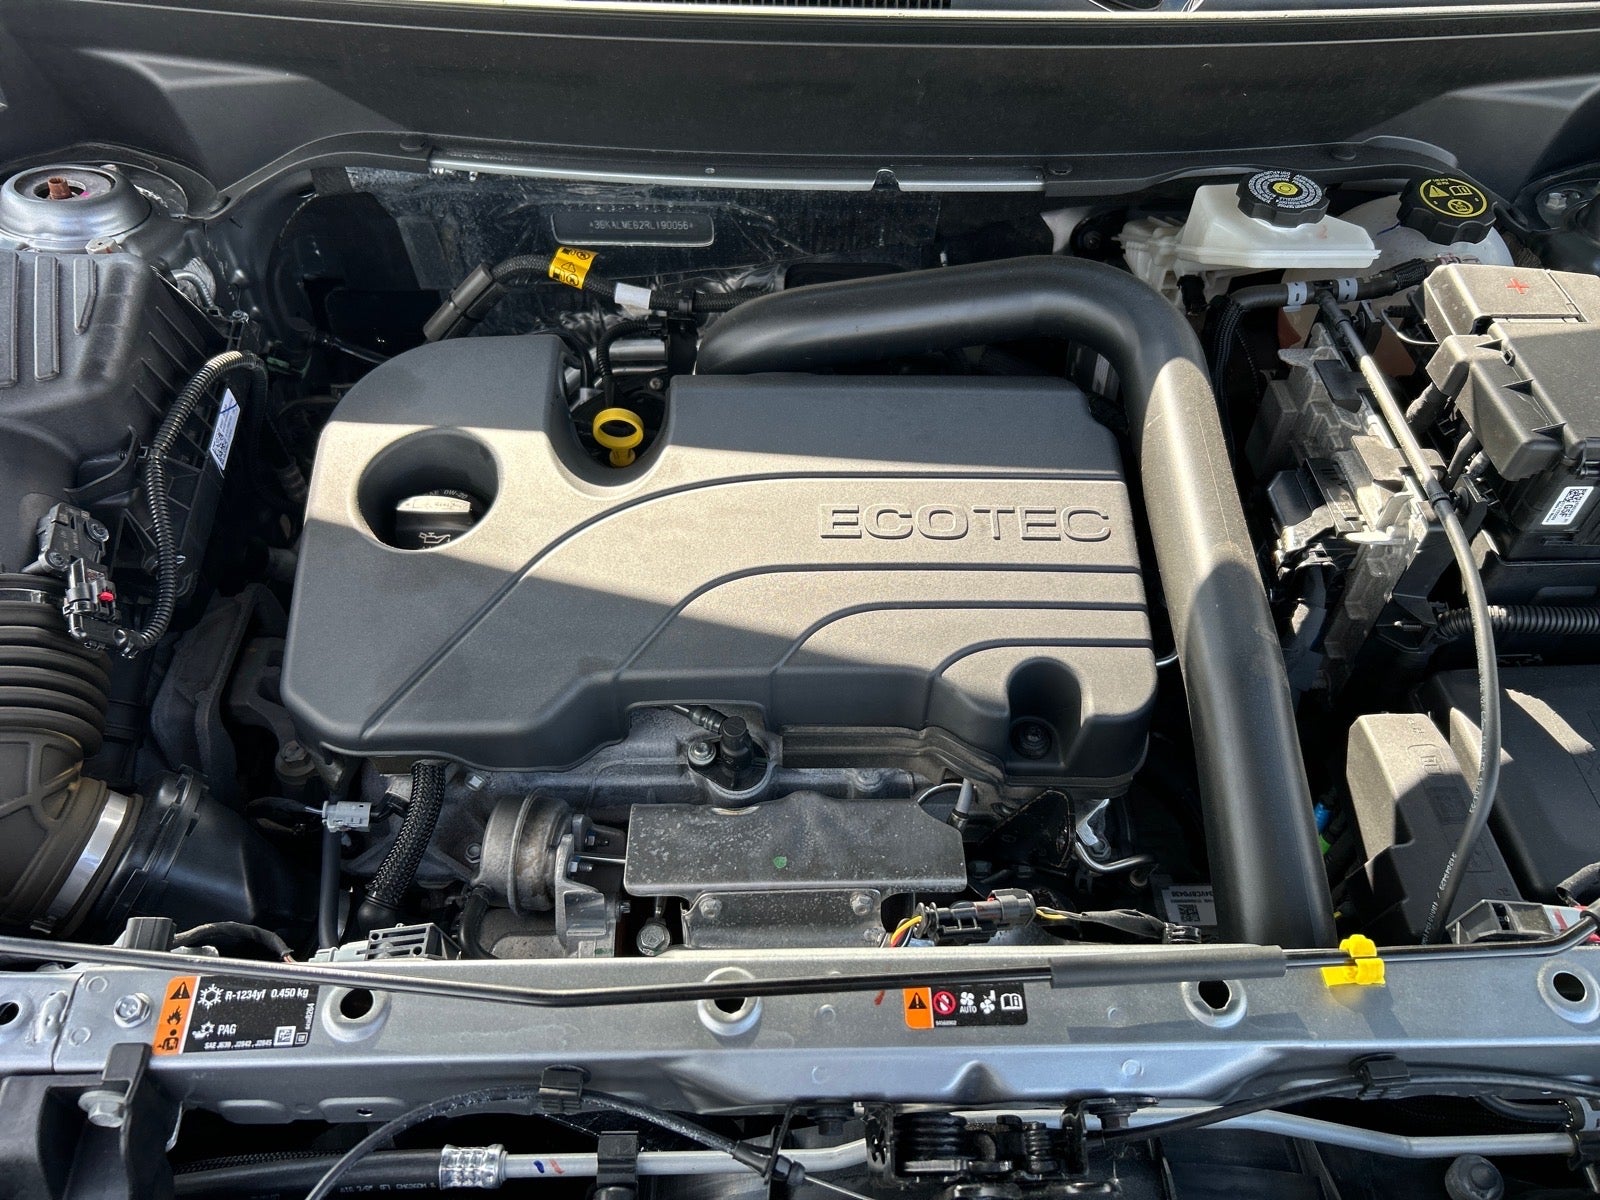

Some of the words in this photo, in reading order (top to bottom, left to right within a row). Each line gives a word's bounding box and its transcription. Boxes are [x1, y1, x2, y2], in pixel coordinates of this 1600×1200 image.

[443, 489, 468, 499] 0W-20
[819, 503, 1112, 542] ECOTEC
[225, 988, 266, 1001] R-1234yf
[271, 988, 296, 998] 0.450
[297, 987, 309, 998] kg
[960, 1006, 977, 1014] AUTO
[218, 1024, 237, 1035] PAG
[204, 1041, 217, 1050] SAE
